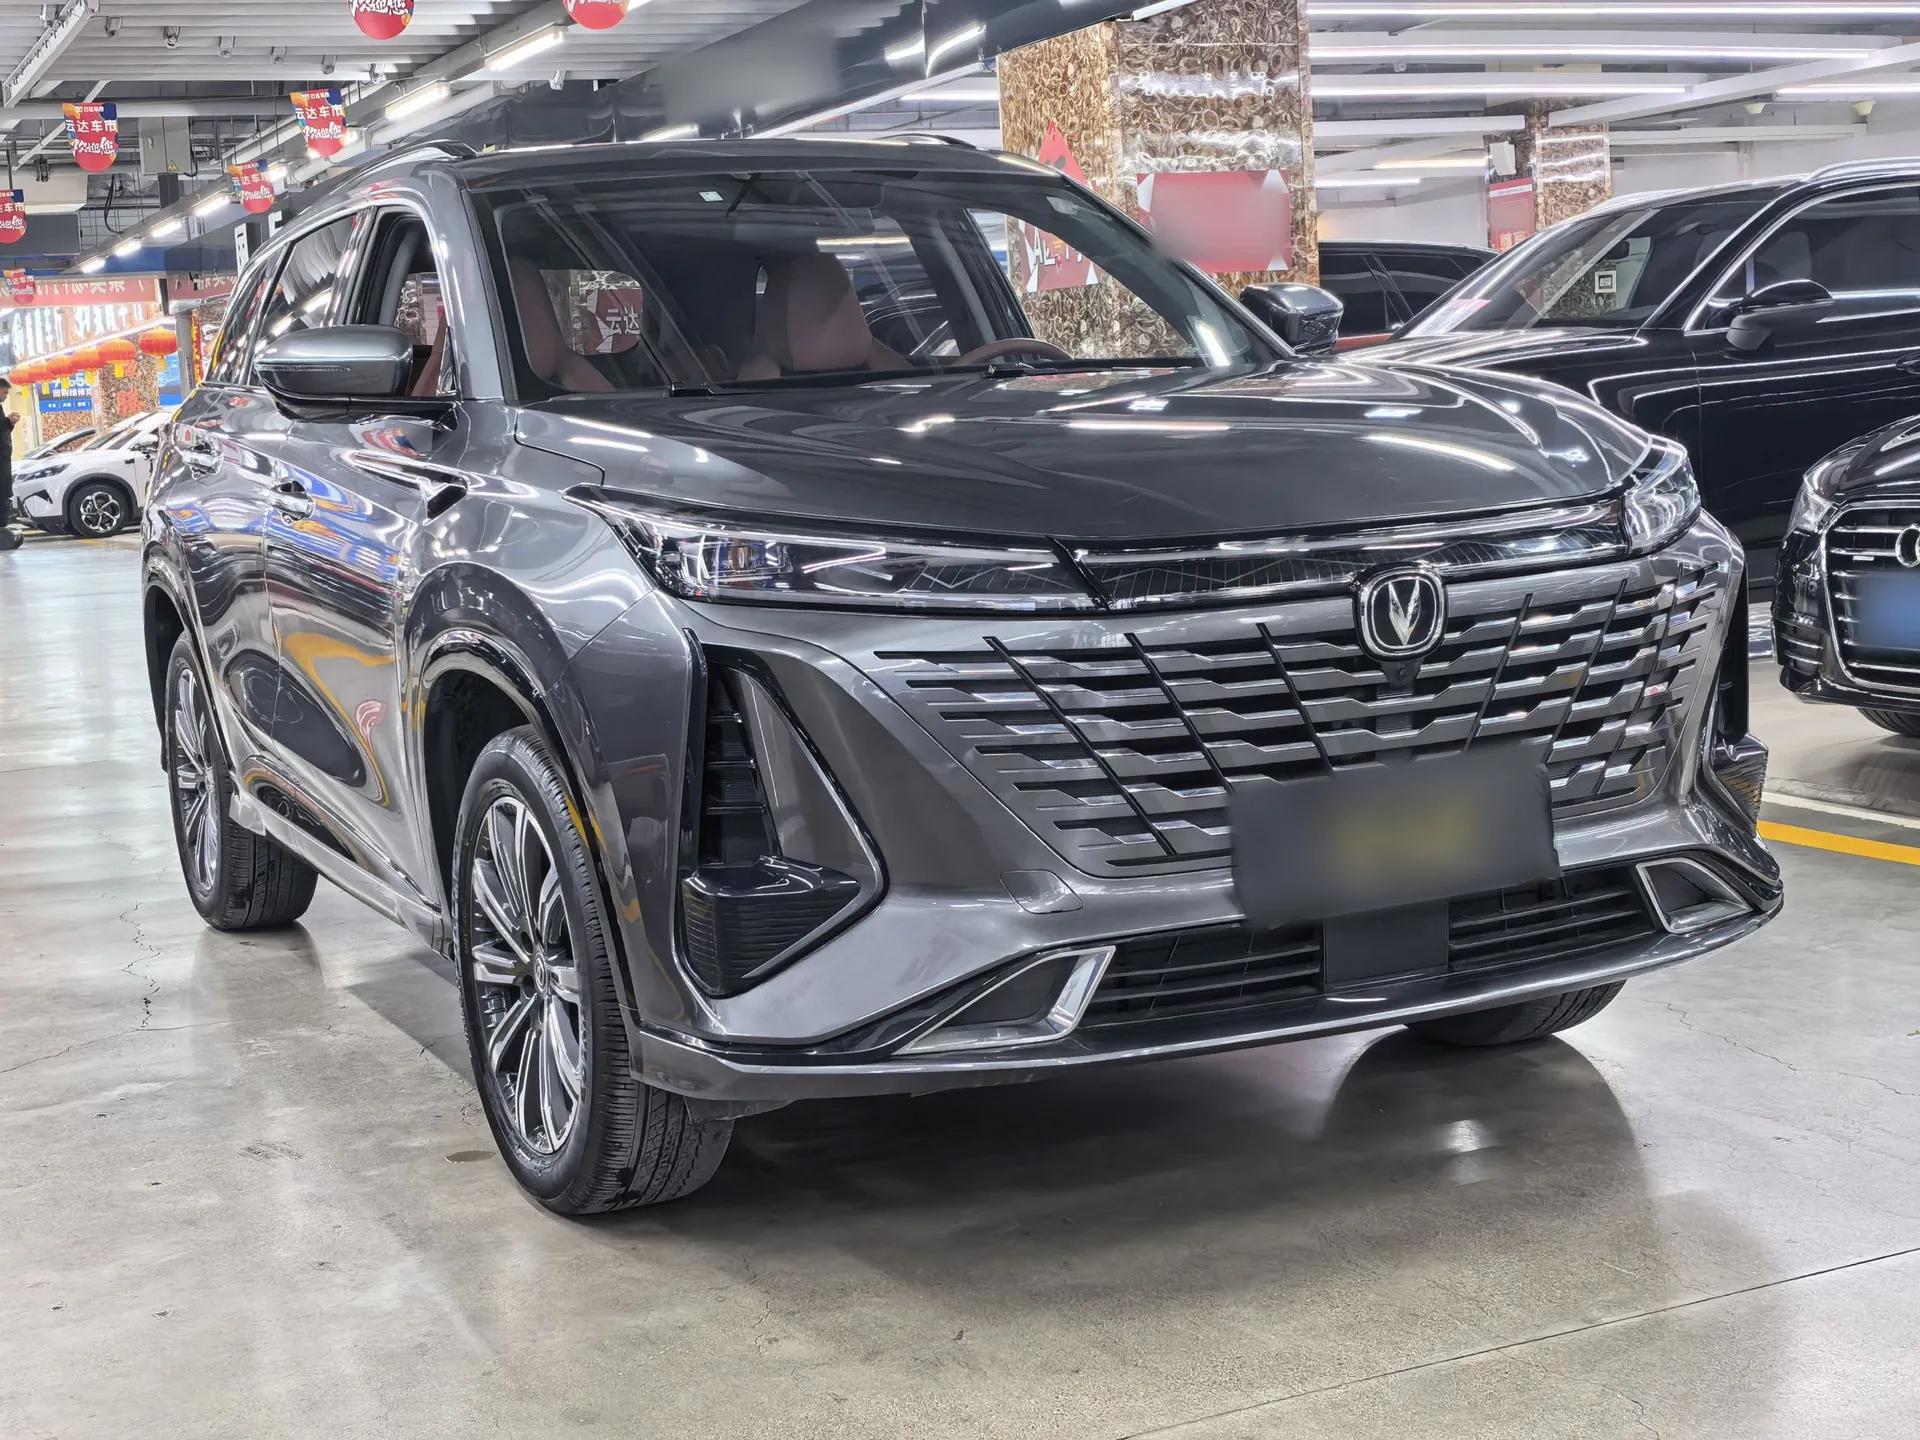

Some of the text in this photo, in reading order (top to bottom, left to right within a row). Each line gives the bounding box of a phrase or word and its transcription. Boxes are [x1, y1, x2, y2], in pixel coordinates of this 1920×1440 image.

[294, 104, 346, 120] 云达车市
[65, 119, 119, 133] 云达车市
[605, 304, 642, 335] 云达
